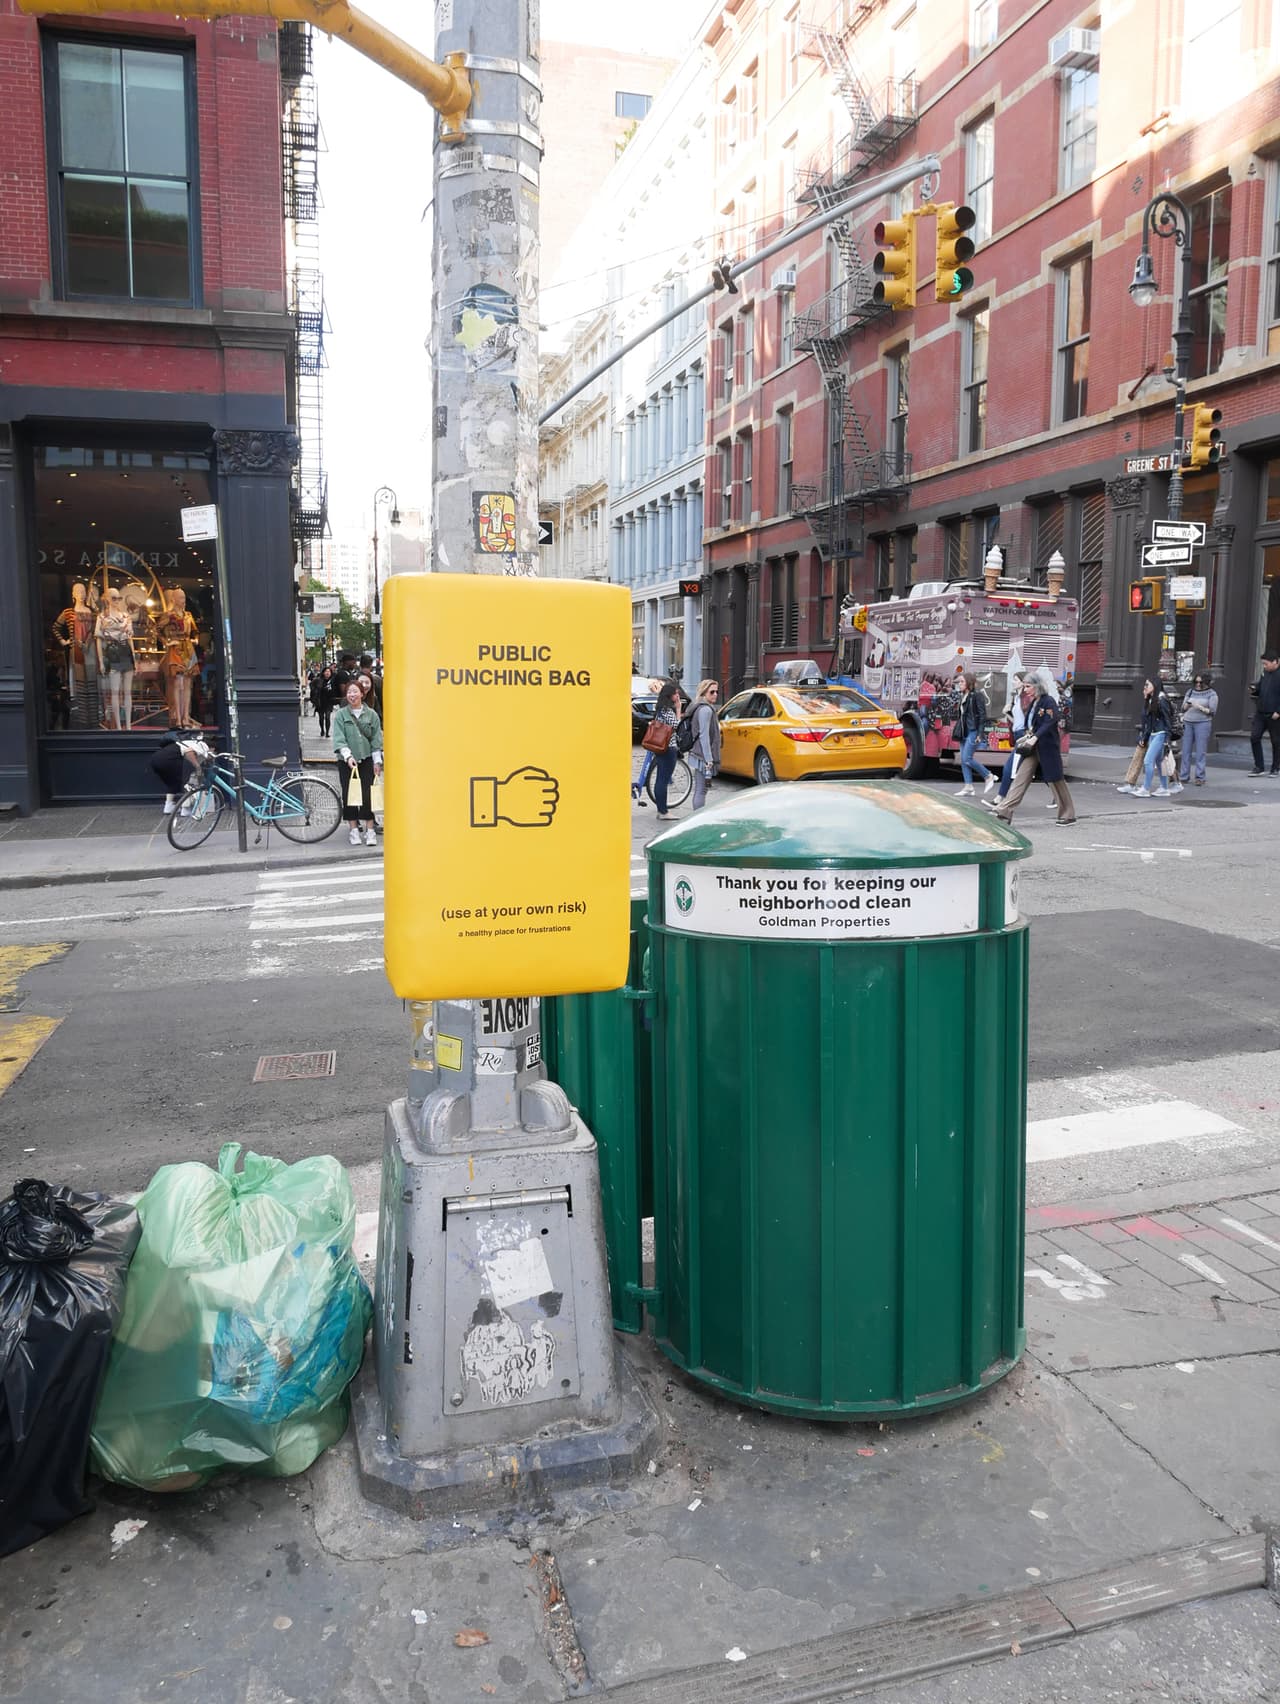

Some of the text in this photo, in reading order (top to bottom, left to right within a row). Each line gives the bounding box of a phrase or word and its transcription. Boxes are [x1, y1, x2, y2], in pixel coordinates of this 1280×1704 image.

[1127, 456, 1169, 473] GREENE ST
[1161, 527, 1197, 538] ONE WAY
[1149, 549, 1185, 561] ONE WAY
[683, 583, 698, 593] Y-3
[983, 606, 1056, 617] WATCH FOR CHILDREN
[479, 645, 551, 662] PUBLIC
[437, 669, 590, 686] PUNCHING BAG
[716, 876, 937, 892] Thank you for keeping our
[441, 900, 587, 922] (use at your own risk)
[740, 896, 911, 911] neighborhood clean
[759, 915, 891, 928] Goldman Properties
[465, 929, 492, 937] healthy
[494, 928, 515, 936] place
[528, 924, 571, 934] frustrations
[483, 998, 530, 1034] ABOVE
